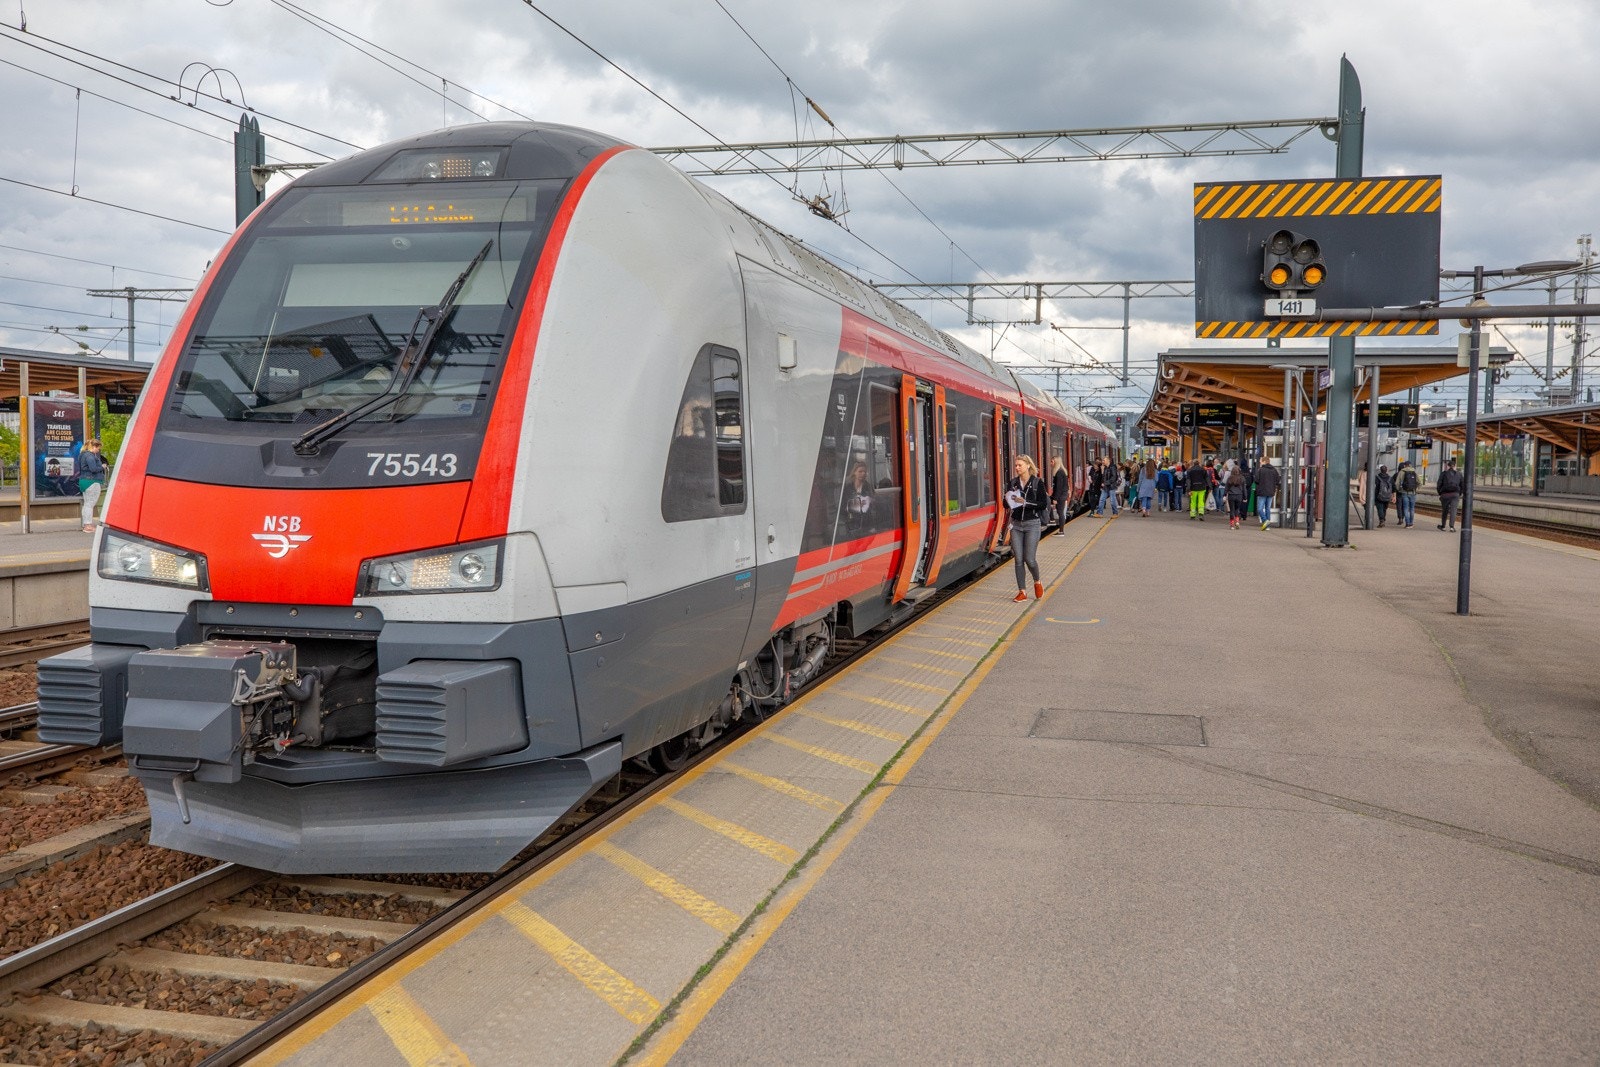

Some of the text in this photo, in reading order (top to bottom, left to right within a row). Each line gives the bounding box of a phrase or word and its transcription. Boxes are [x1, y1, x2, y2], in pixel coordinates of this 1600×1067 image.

[1278, 300, 1302, 314] 1411
[1183, 414, 1190, 423] 6
[1408, 415, 1415, 424] 7
[367, 453, 458, 477] 75543
[263, 515, 302, 532] NSB
